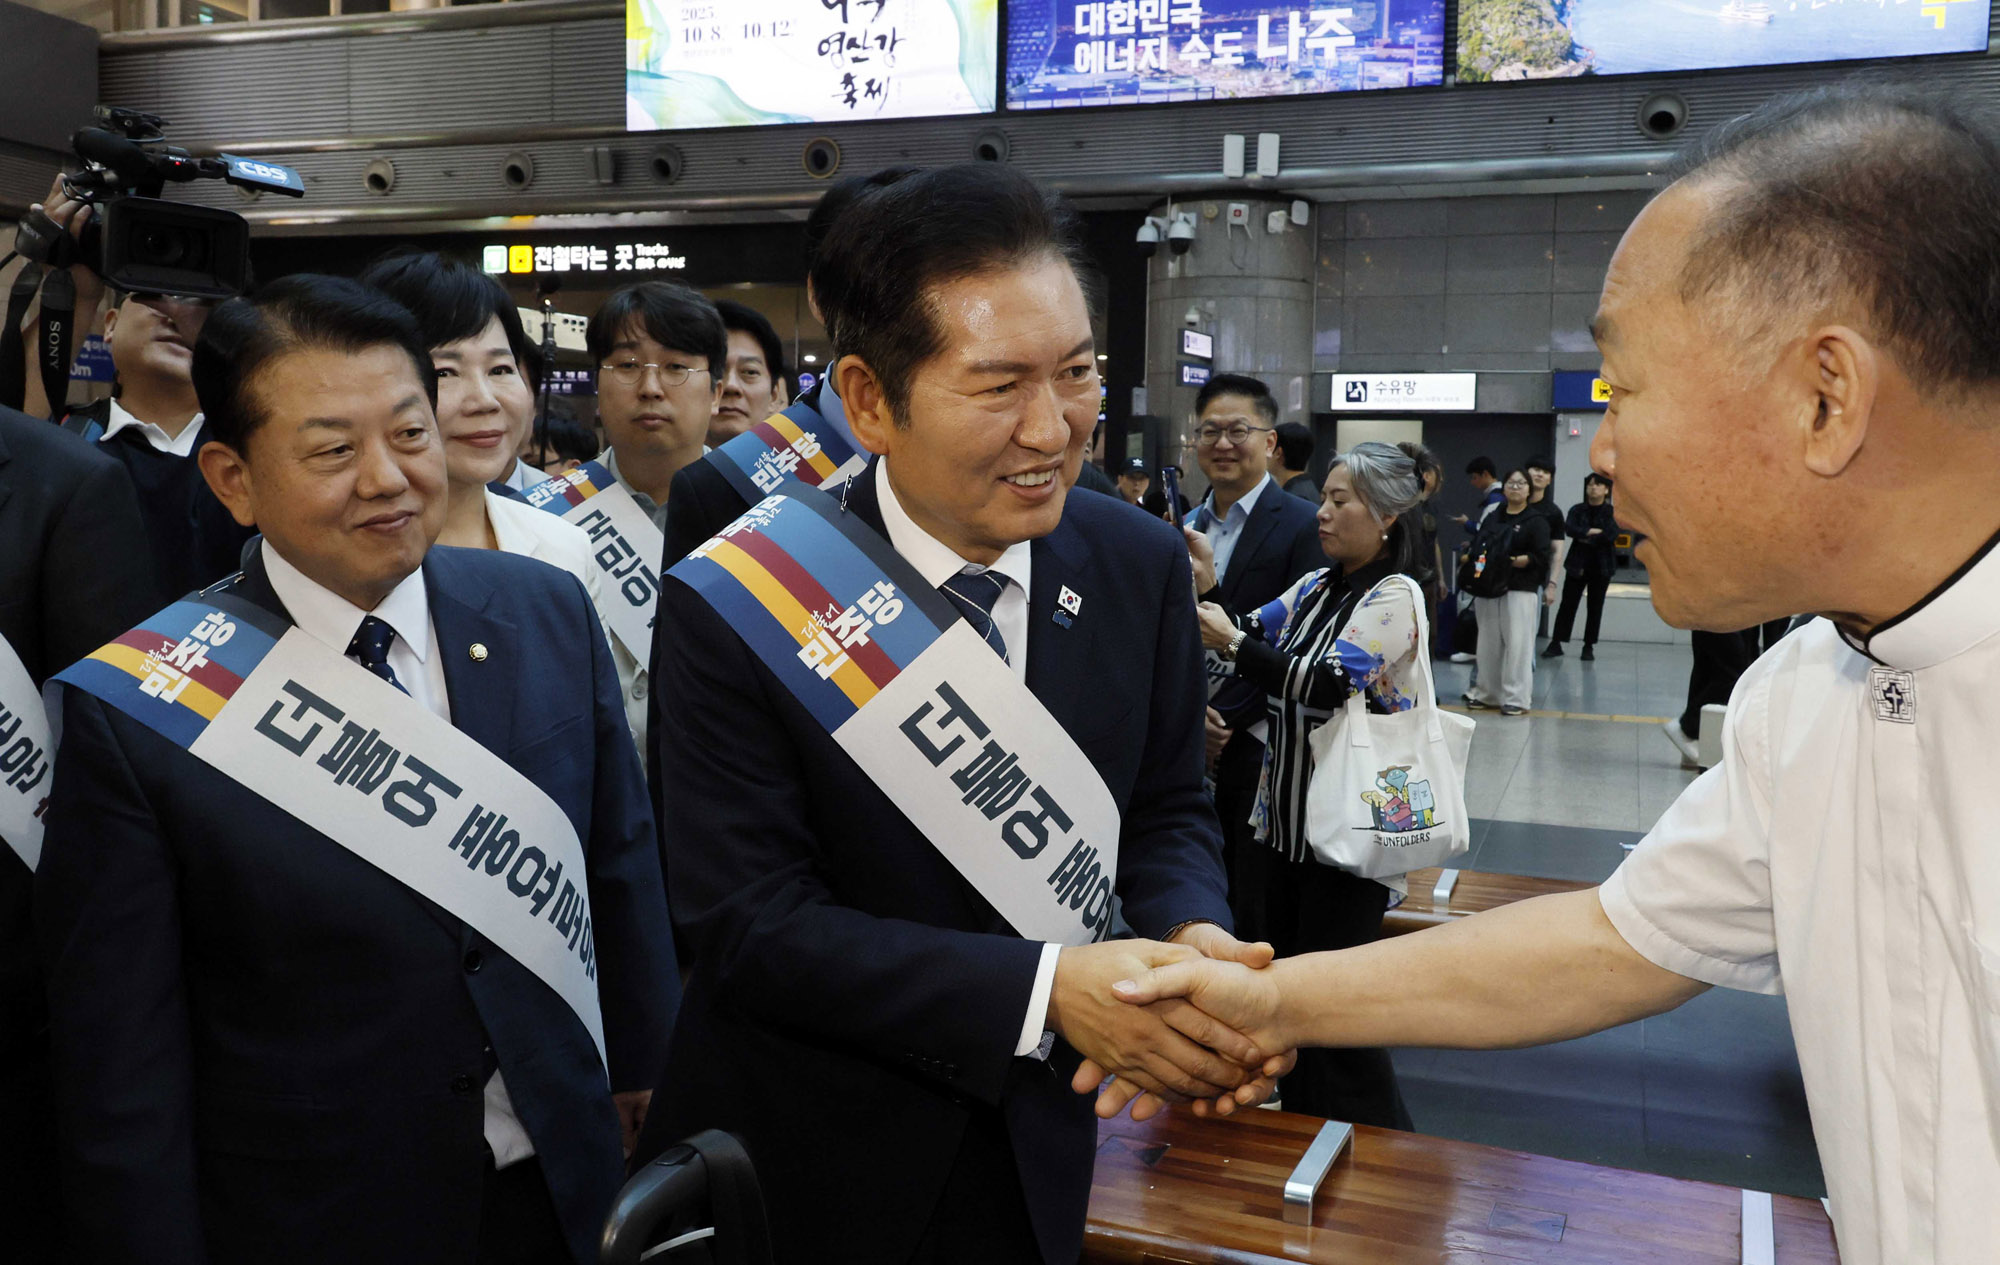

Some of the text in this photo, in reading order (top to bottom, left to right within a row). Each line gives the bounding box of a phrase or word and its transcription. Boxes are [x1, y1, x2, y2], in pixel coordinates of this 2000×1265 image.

[1074, 0, 1203, 36] 대한민국
[818, 27, 907, 69] 영산강
[1074, 8, 1356, 74] 에너지 수도 나주
[832, 72, 890, 114] 축제
[237, 161, 288, 182] CBS
[534, 245, 608, 271] 전철타는
[614, 244, 634, 271] 곳
[49, 321, 61, 370] SONY
[1375, 380, 1418, 396] 수유방
[750, 432, 822, 494] 민주당
[526, 469, 589, 508] 민주당
[797, 580, 904, 681] 민주당
[801, 602, 840, 641] 더불어
[138, 611, 236, 704] 민주당
[140, 640, 176, 674] 더불어
[254, 679, 464, 828] 더불어
[898, 680, 1074, 860] 더불어
[1384, 832, 1431, 847] UNFOLDERS
